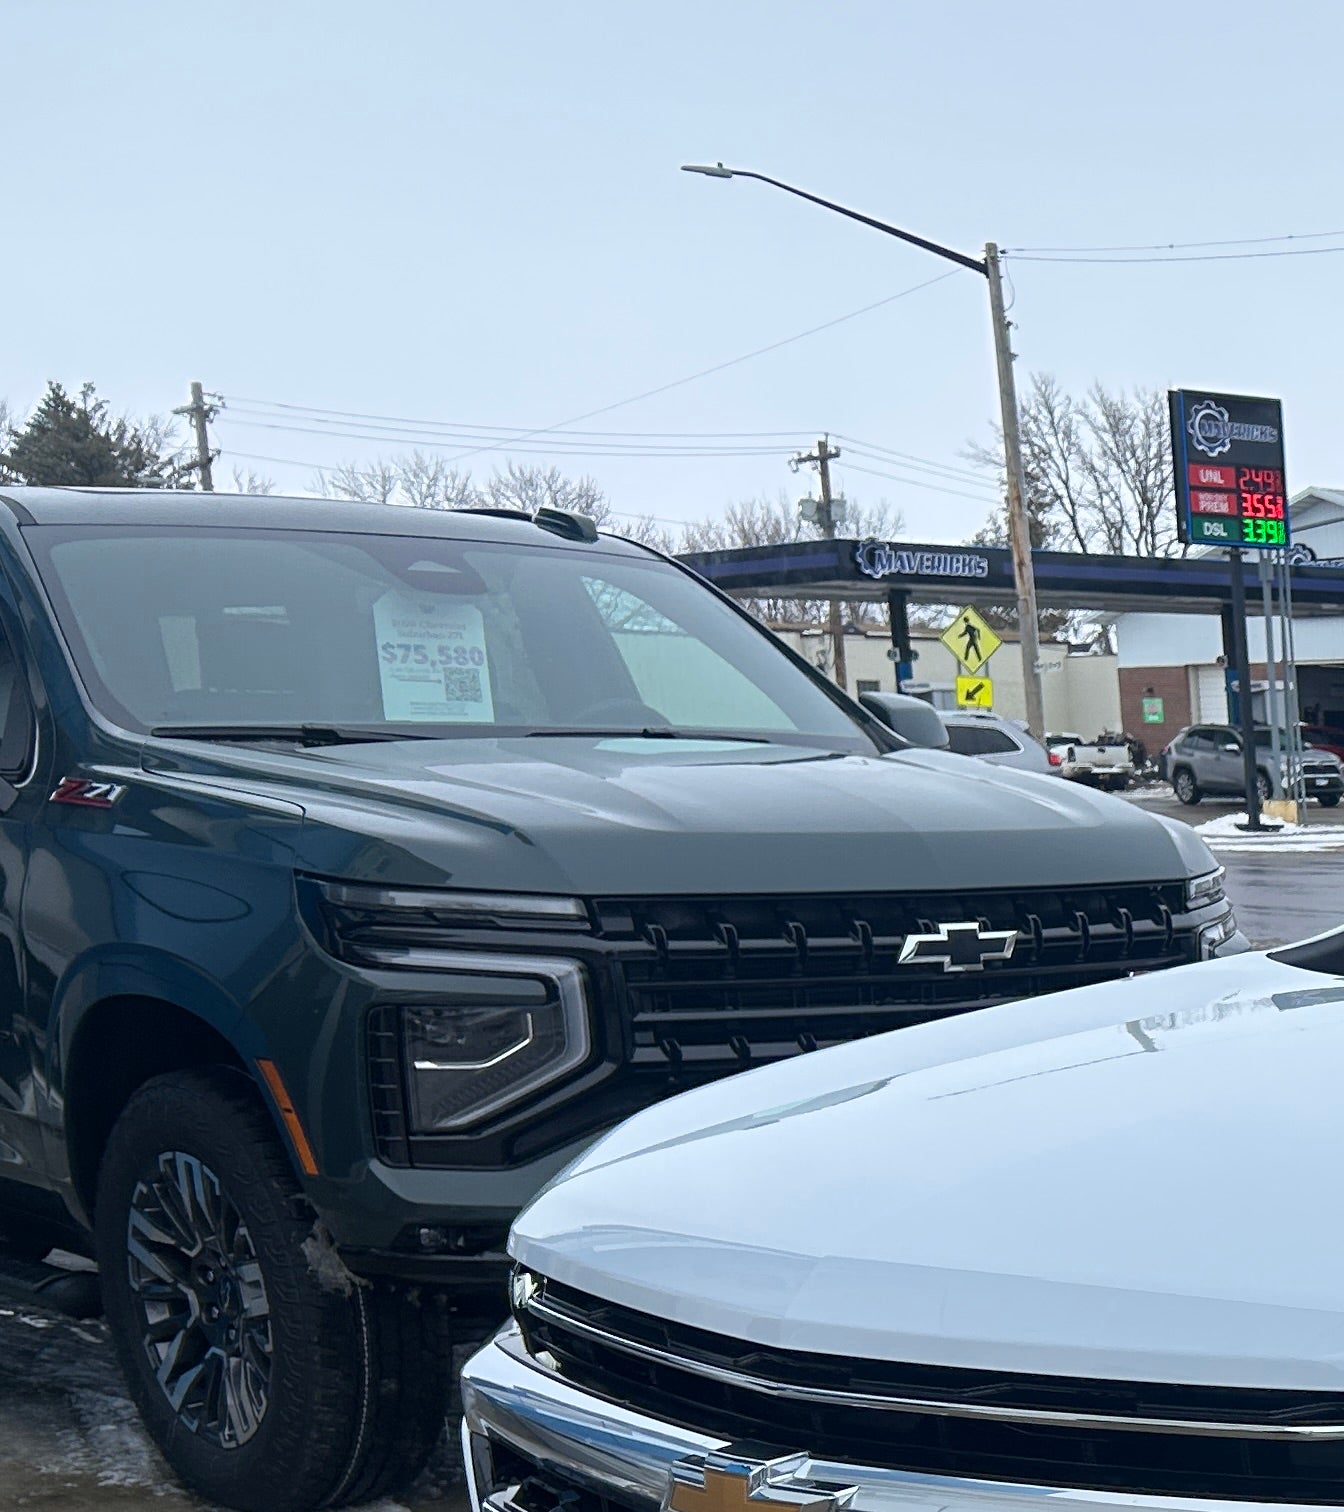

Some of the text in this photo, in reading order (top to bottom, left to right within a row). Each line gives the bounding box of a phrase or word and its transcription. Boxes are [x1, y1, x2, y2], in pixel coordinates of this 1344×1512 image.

[1199, 468, 1225, 484] UNL
[1203, 521, 1228, 537] DSL
[381, 642, 484, 667] $75,580
[49, 776, 127, 808] Z71
